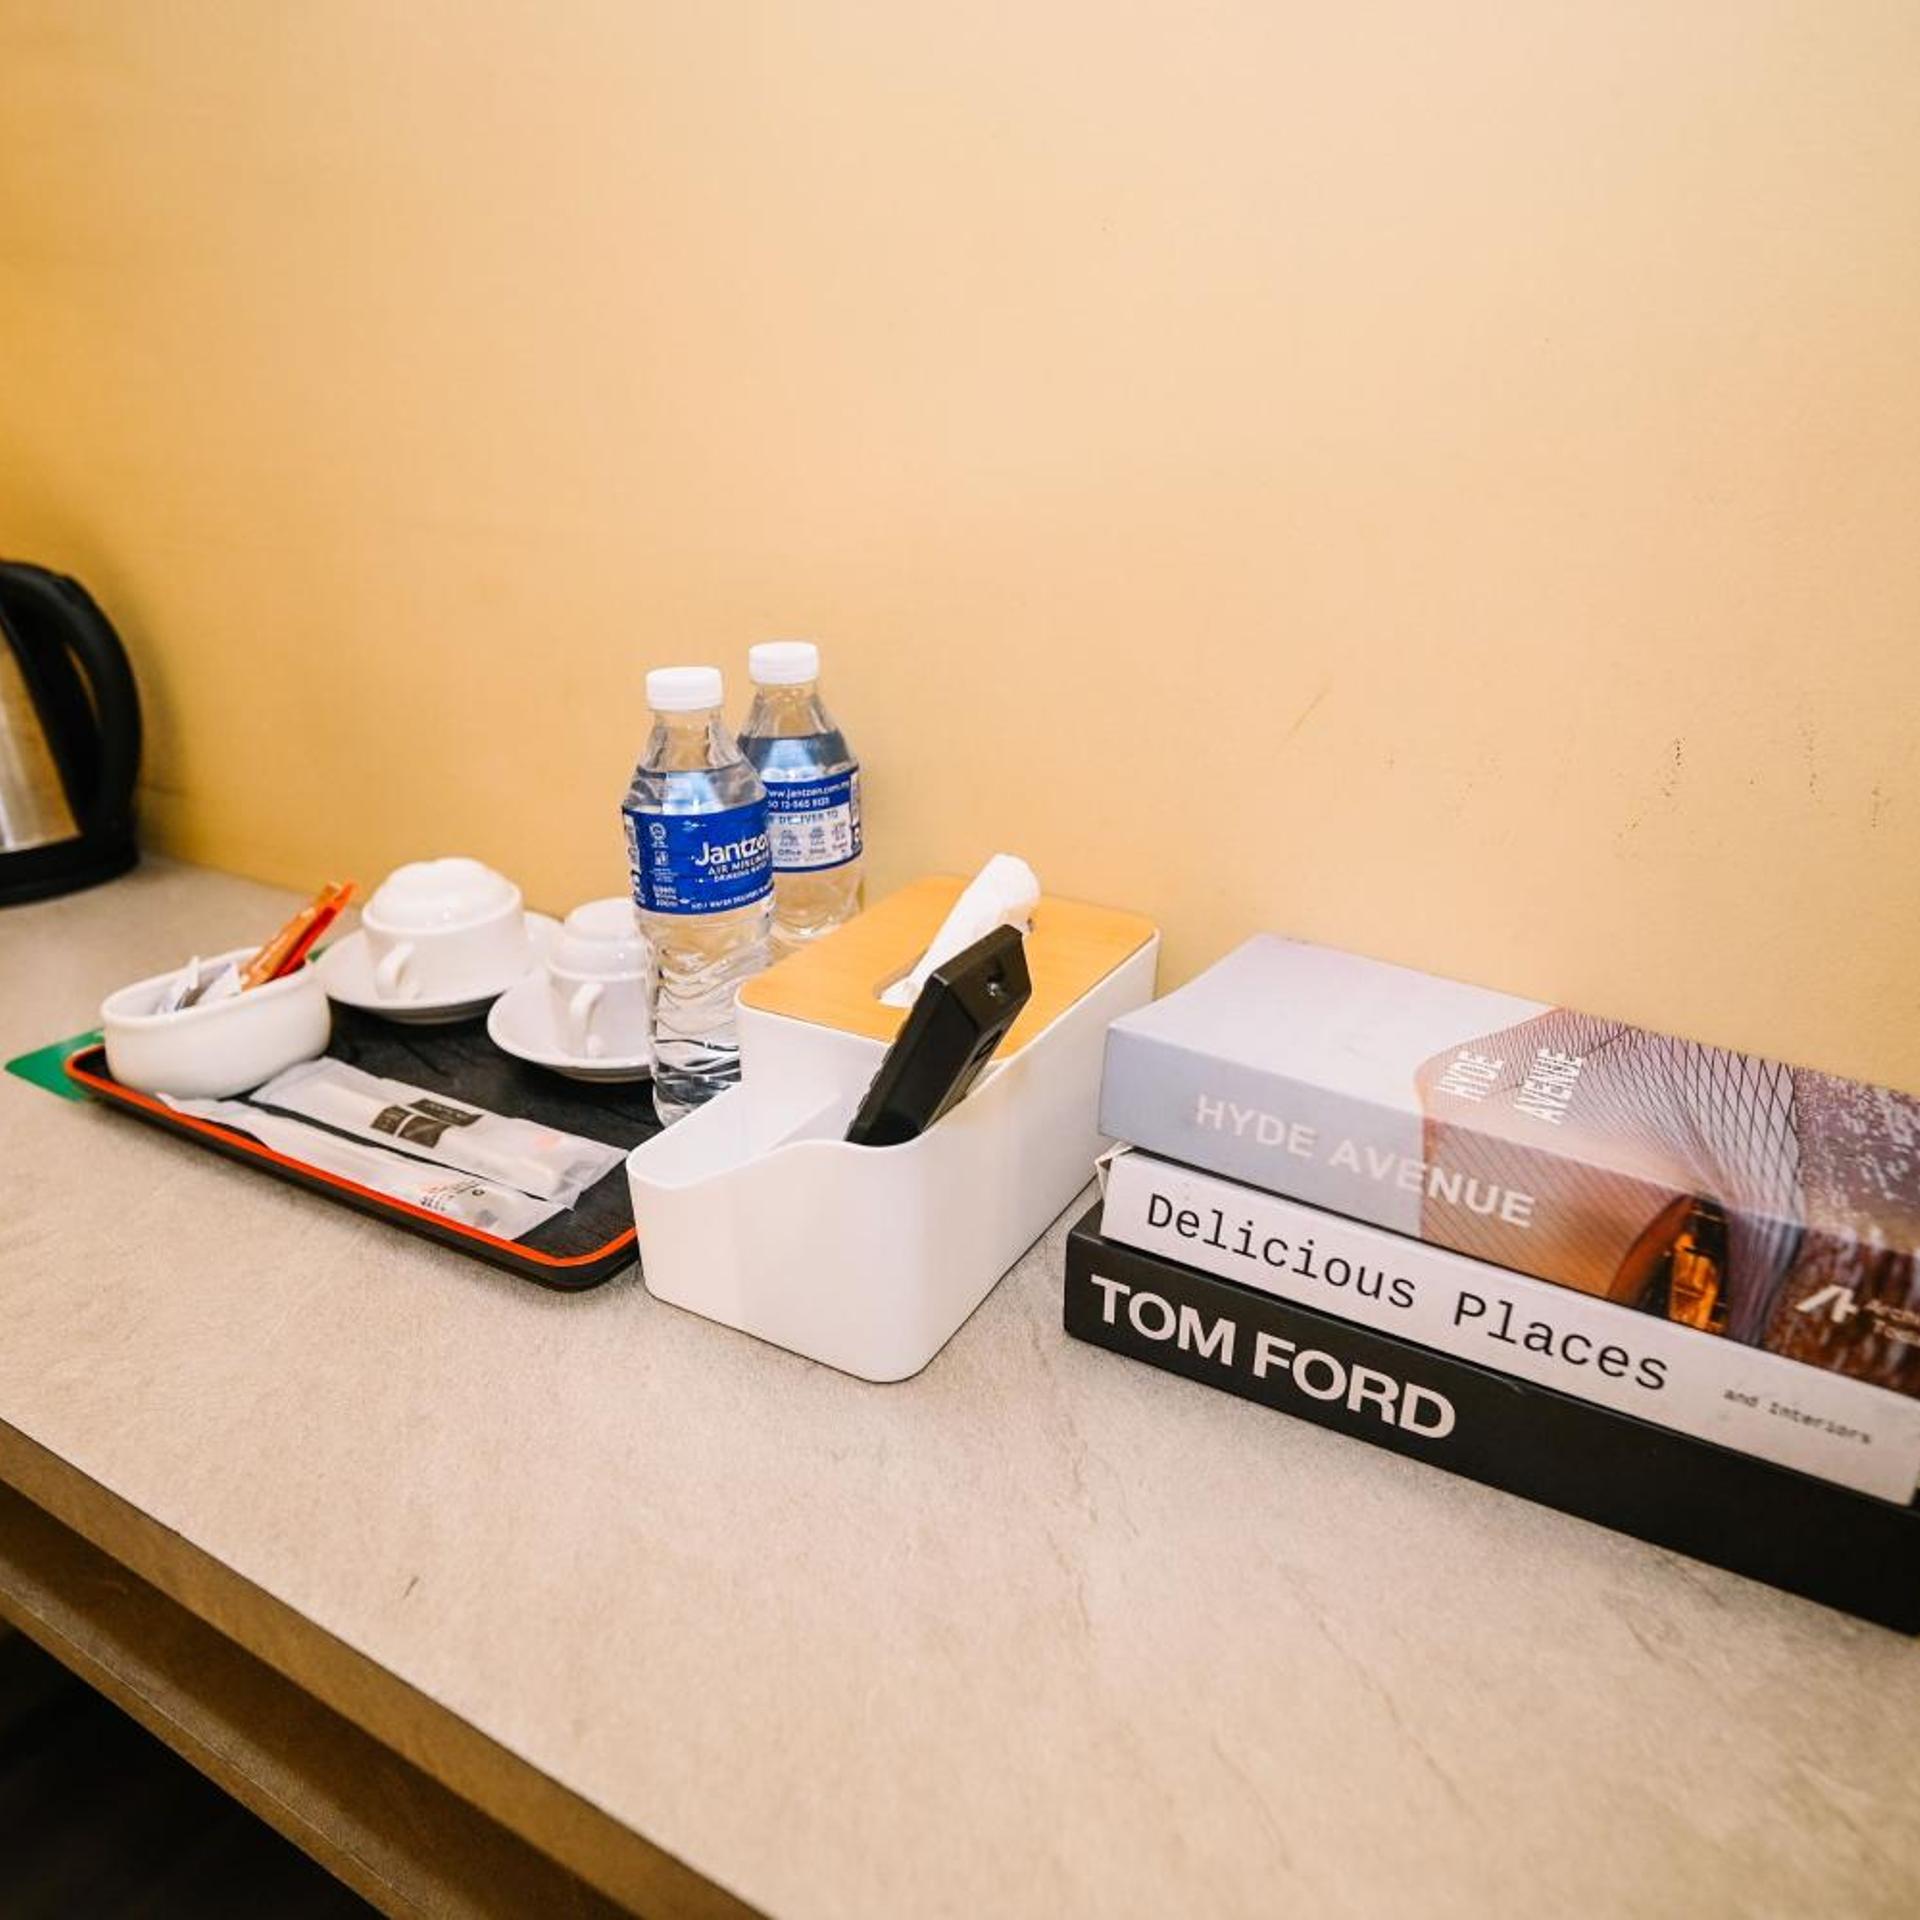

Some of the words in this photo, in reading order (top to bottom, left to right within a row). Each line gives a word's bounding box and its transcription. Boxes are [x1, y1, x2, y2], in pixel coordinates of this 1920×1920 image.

[694, 832, 769, 867] Jantze
[1434, 1051, 1504, 1102] HYDE
[1514, 1048, 1584, 1125] AVENUE
[1196, 1094, 1319, 1158] HYDE
[1328, 1138, 1536, 1229] AVENUE
[1147, 1193, 1416, 1309] Delicious
[1453, 1291, 1668, 1390] Places
[1090, 1273, 1237, 1367] TOM
[1252, 1331, 1456, 1440] FORD
[1724, 1387, 1759, 1408] and
